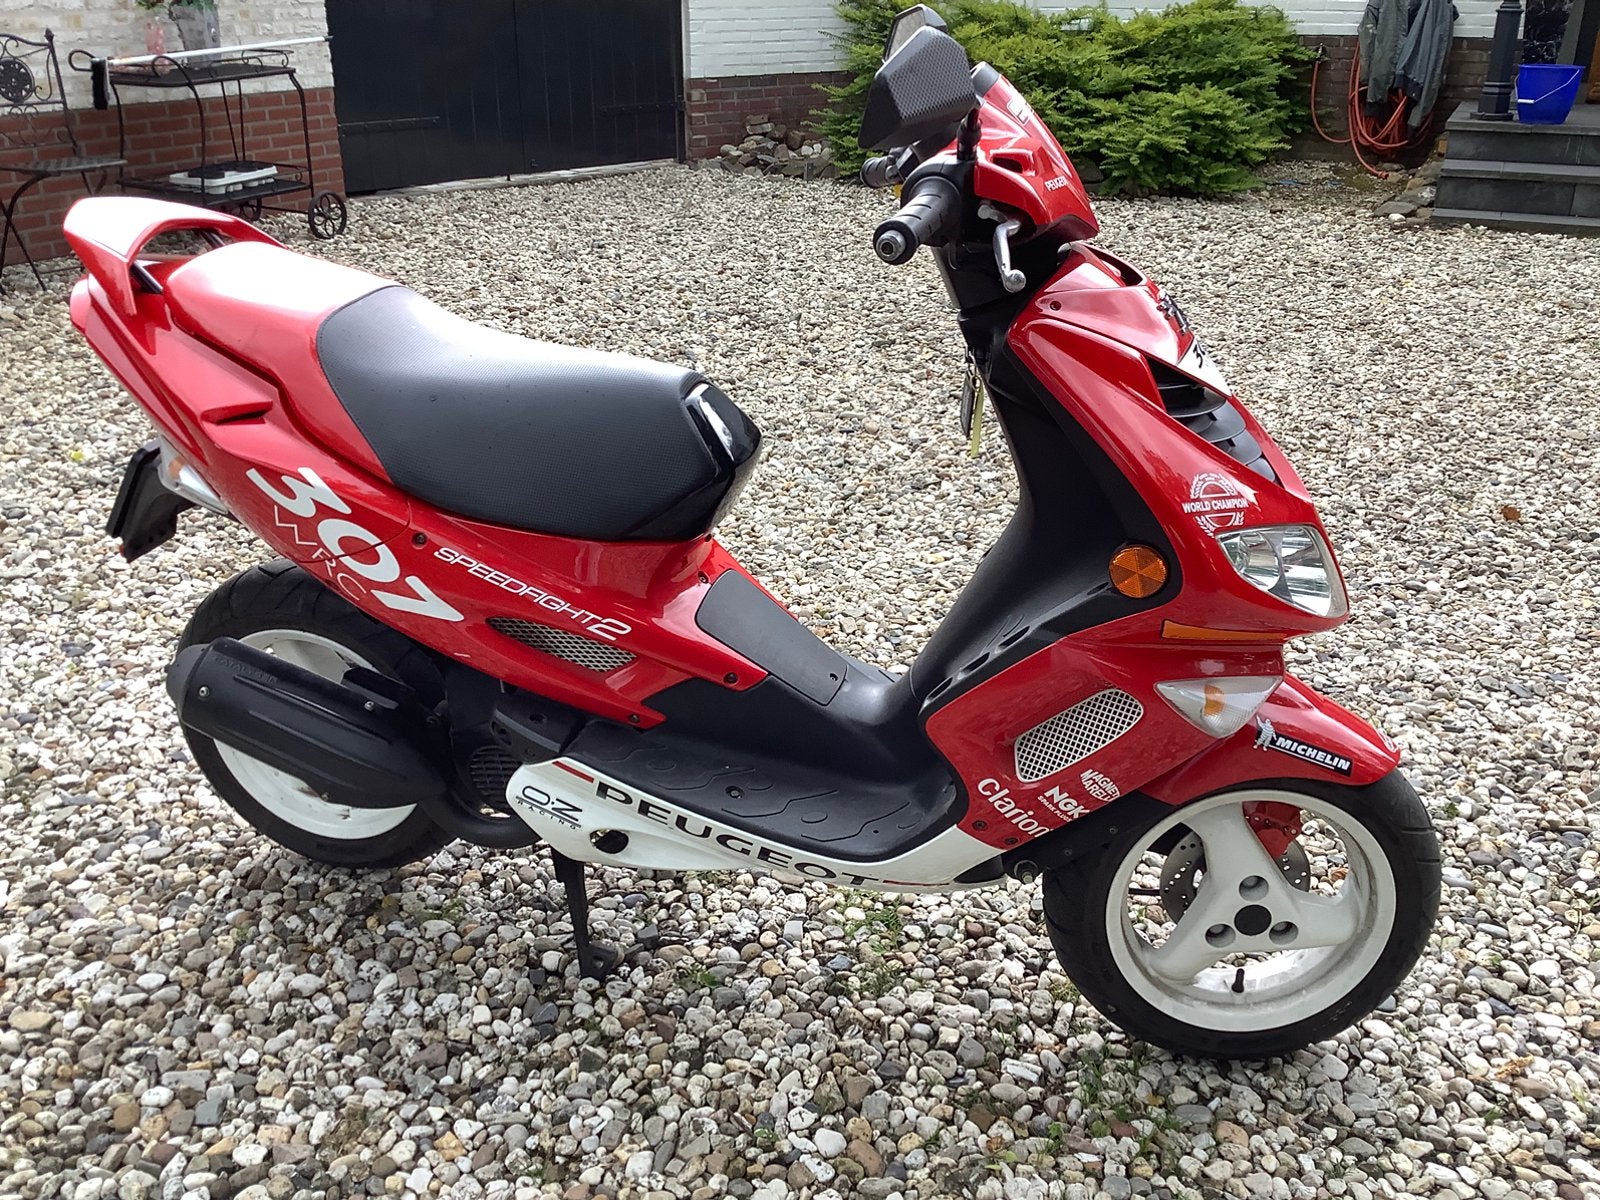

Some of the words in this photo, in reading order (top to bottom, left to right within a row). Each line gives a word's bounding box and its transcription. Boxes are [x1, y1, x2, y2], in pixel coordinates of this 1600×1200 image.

[1181, 502, 1211, 514] WORLD
[1211, 498, 1249, 511] CHAMPION
[246, 467, 464, 622] 307
[273, 505, 360, 601] WRC
[1275, 736, 1351, 771] MICHELIN
[516, 799, 577, 830] RACING
[977, 777, 1053, 838] Clarion
[1037, 795, 1057, 812] SPARK
[1053, 808, 1073, 823] PLUGS
[1043, 785, 1091, 820] NGK
[596, 780, 881, 887] PEUGEOT
